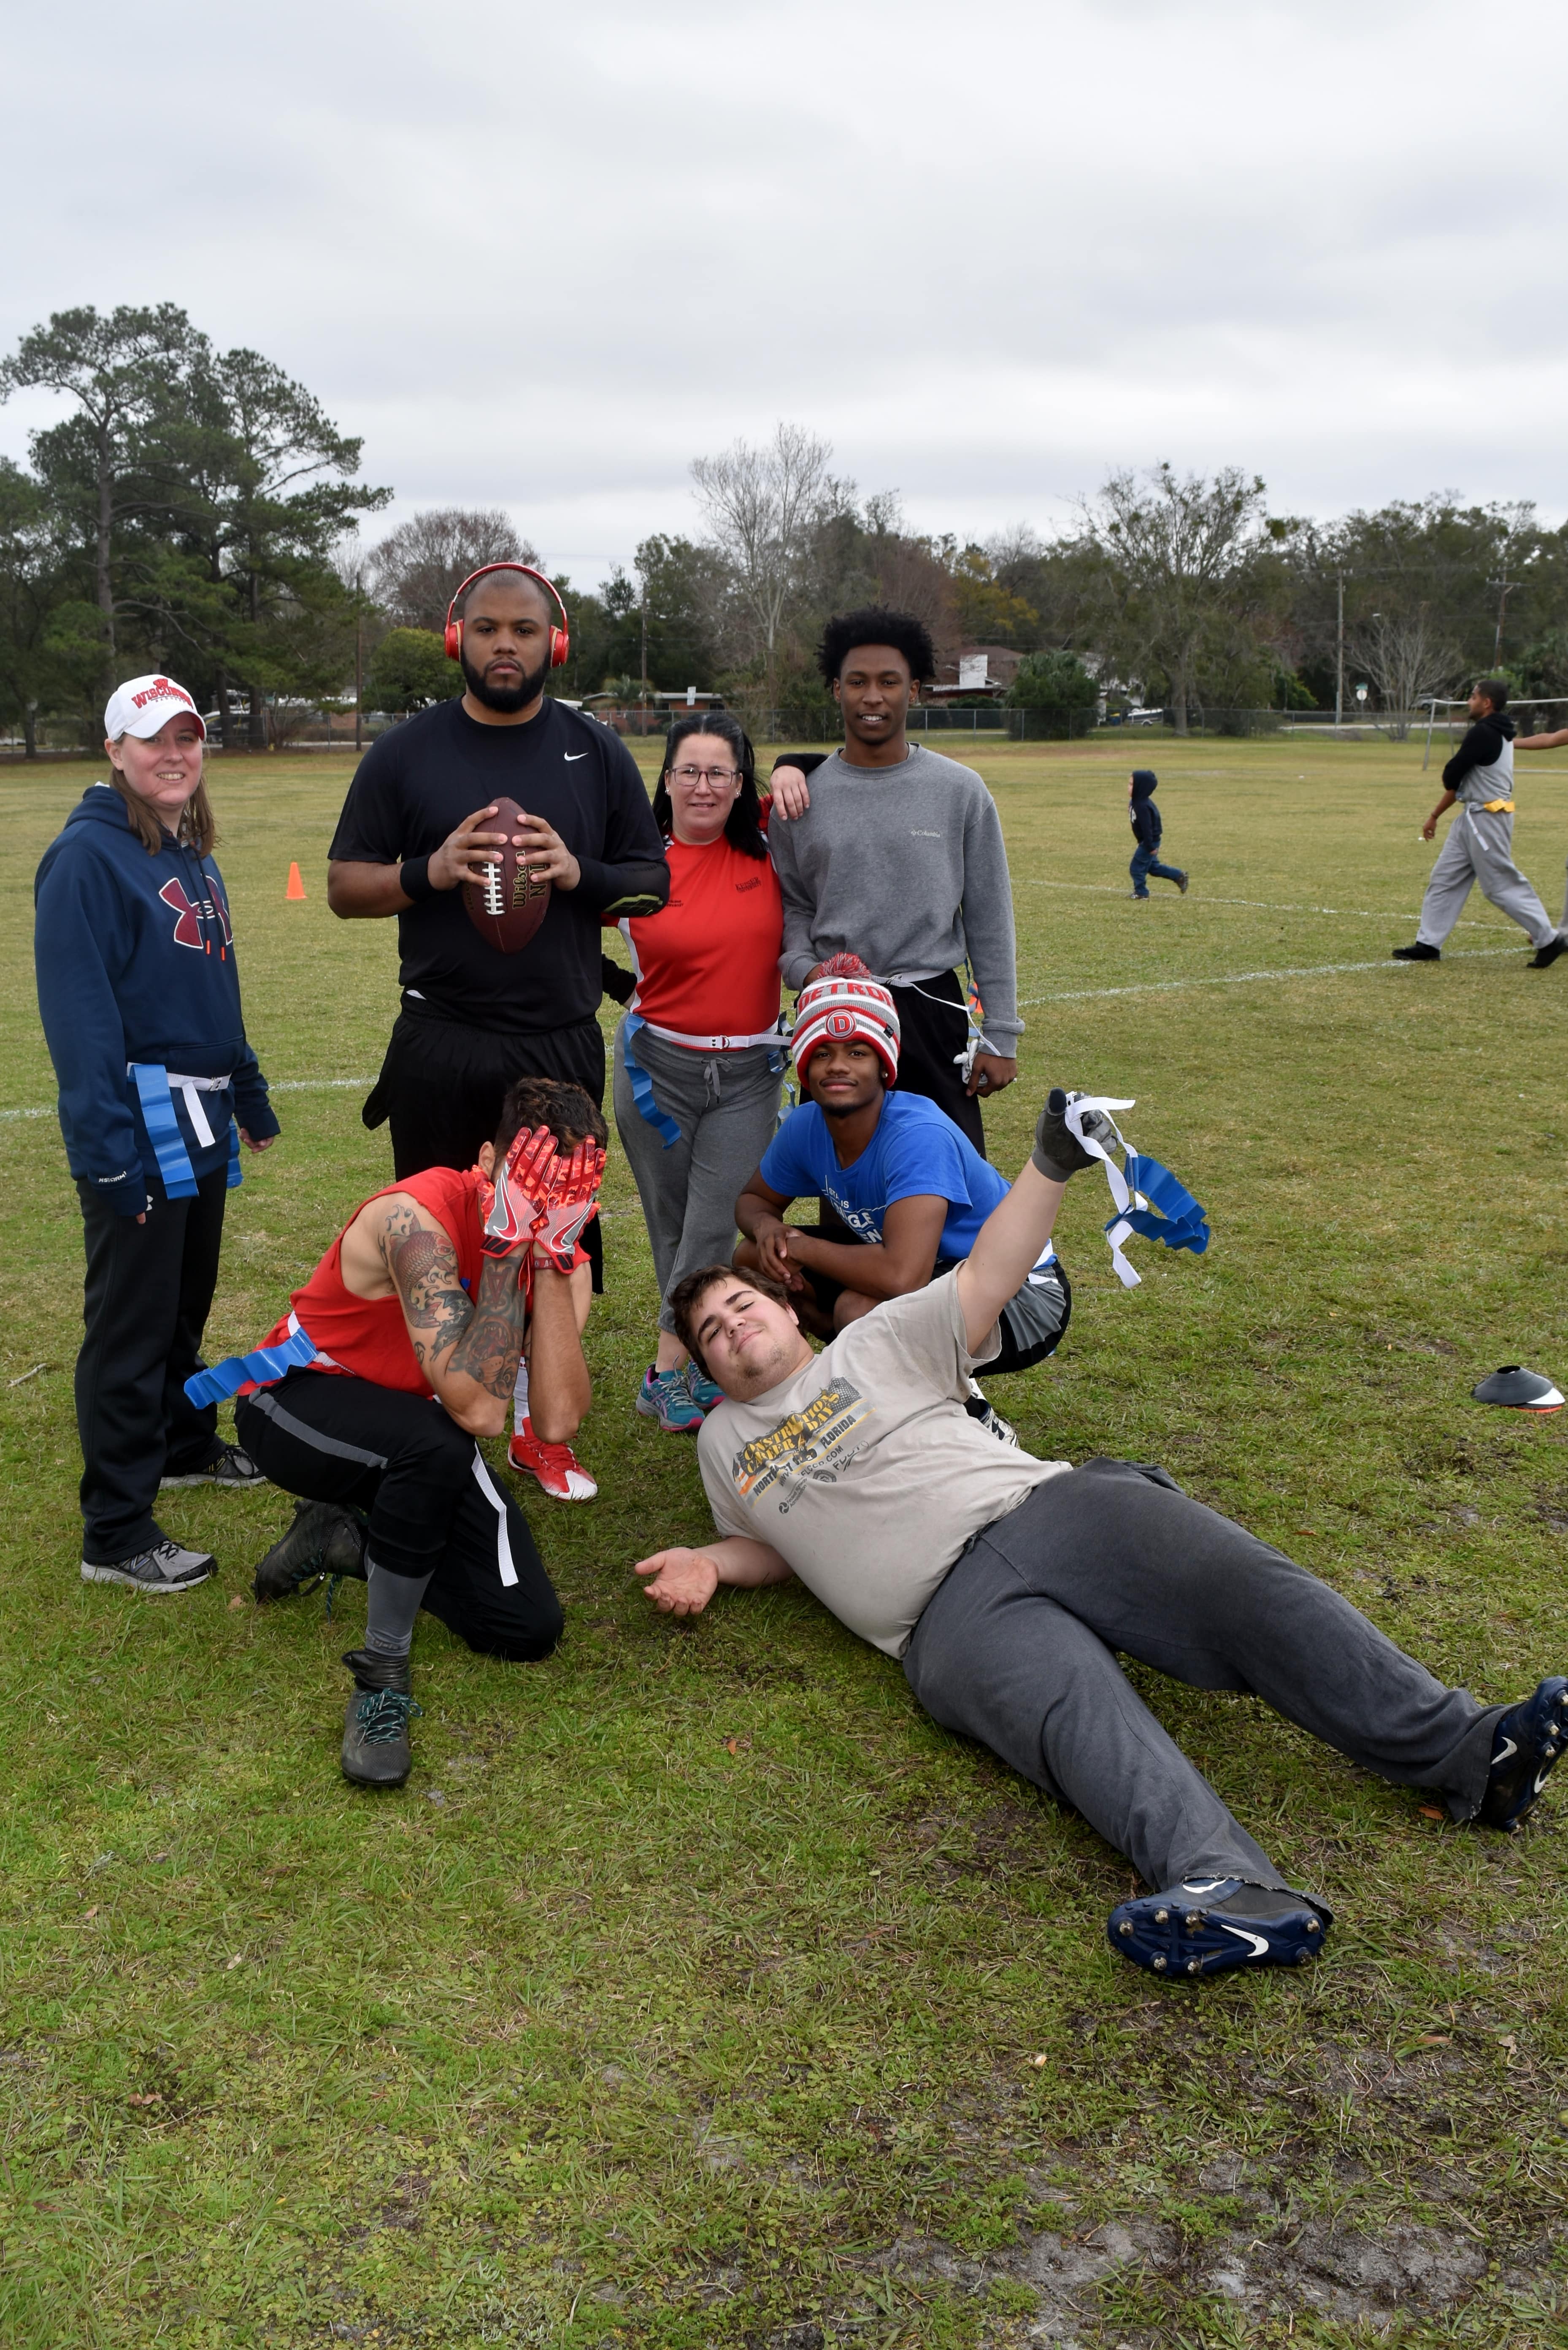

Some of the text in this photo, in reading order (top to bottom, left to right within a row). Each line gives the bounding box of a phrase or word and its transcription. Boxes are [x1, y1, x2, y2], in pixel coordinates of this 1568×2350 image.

[917, 830, 941, 838] Columbia
[529, 864, 547, 899] NL
[798, 982, 892, 1013] DETROI
[833, 1016, 850, 1033] D
[820, 1414, 857, 1449] FLORIDA
